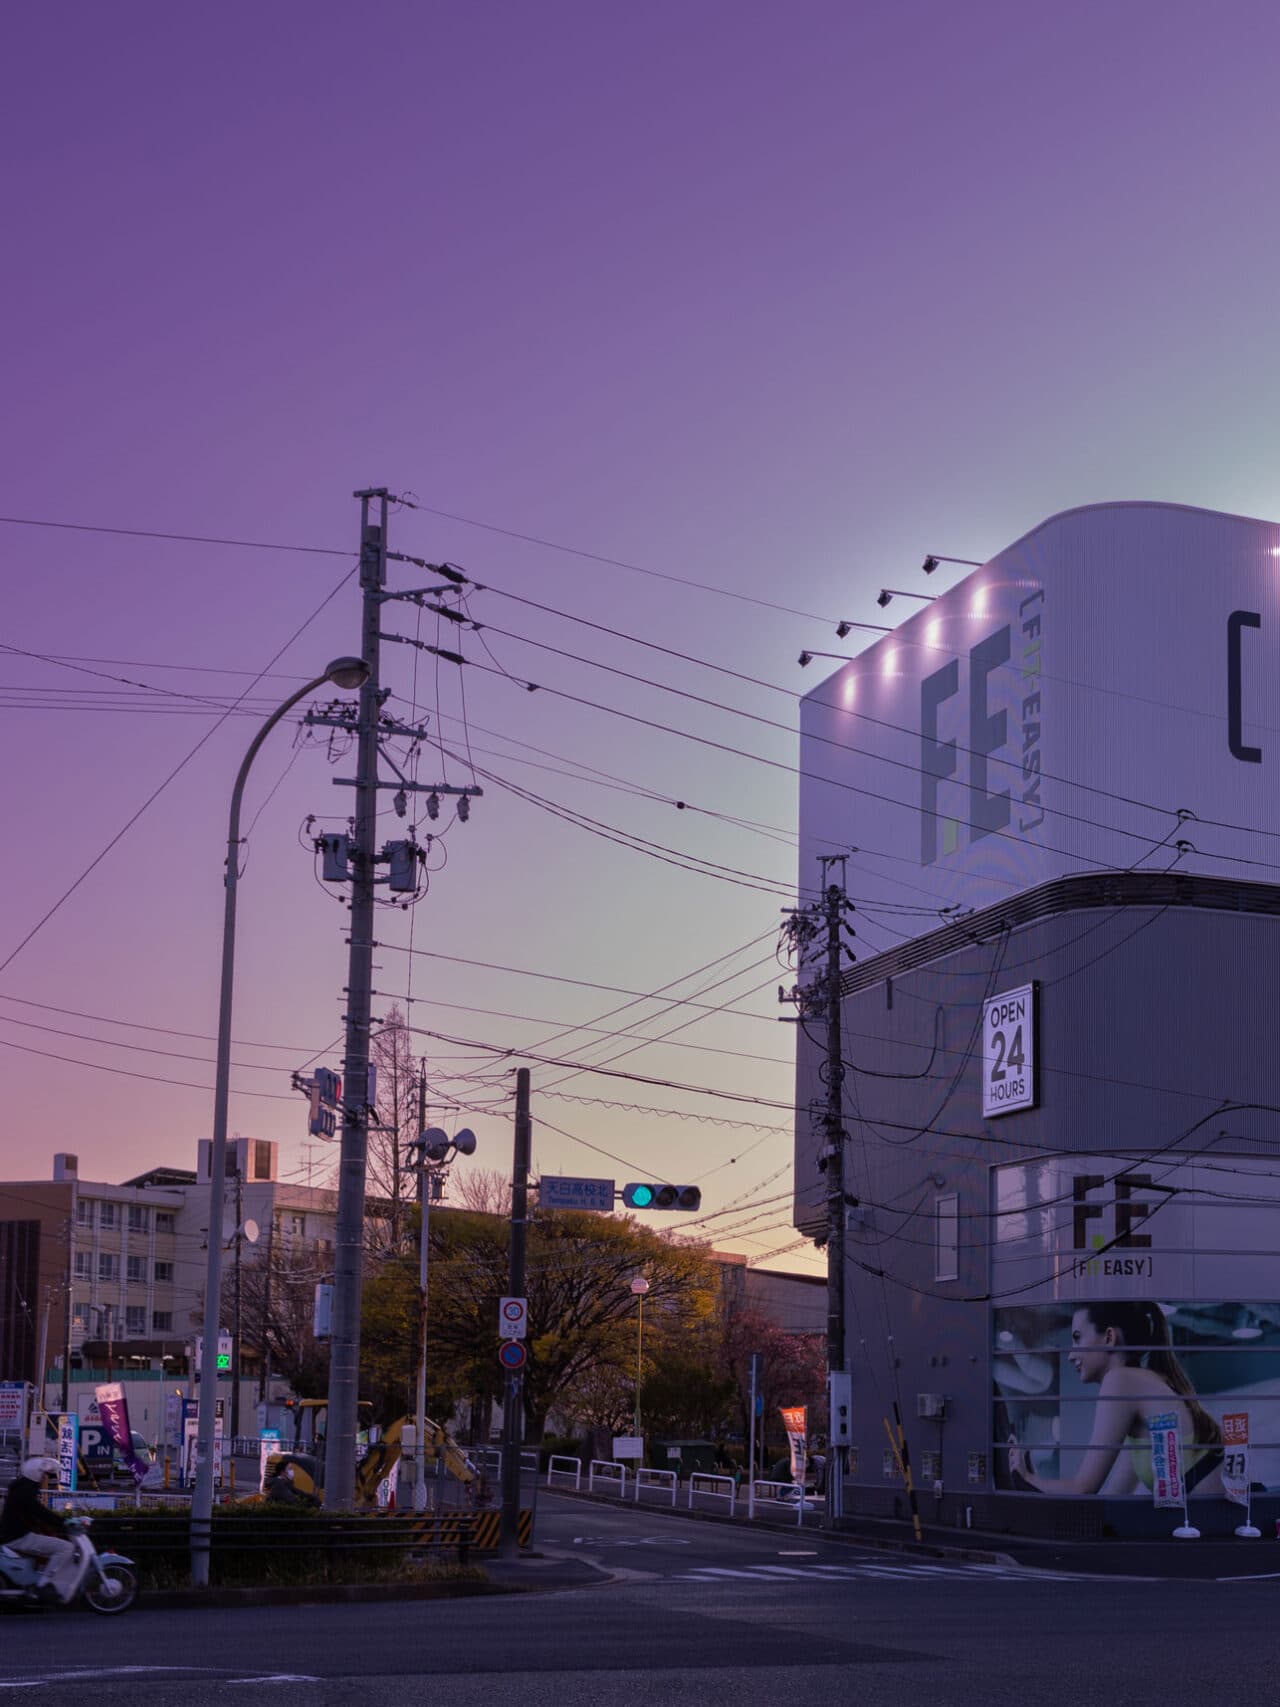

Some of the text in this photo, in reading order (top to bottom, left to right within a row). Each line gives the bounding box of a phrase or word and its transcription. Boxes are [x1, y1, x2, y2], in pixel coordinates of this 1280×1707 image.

[991, 998, 1025, 1028] OPEN
[991, 1025, 1025, 1082] 24
[991, 1079, 1024, 1103] HOURS
[508, 1306, 519, 1316] 30
[81, 1429, 110, 1456] P IN
